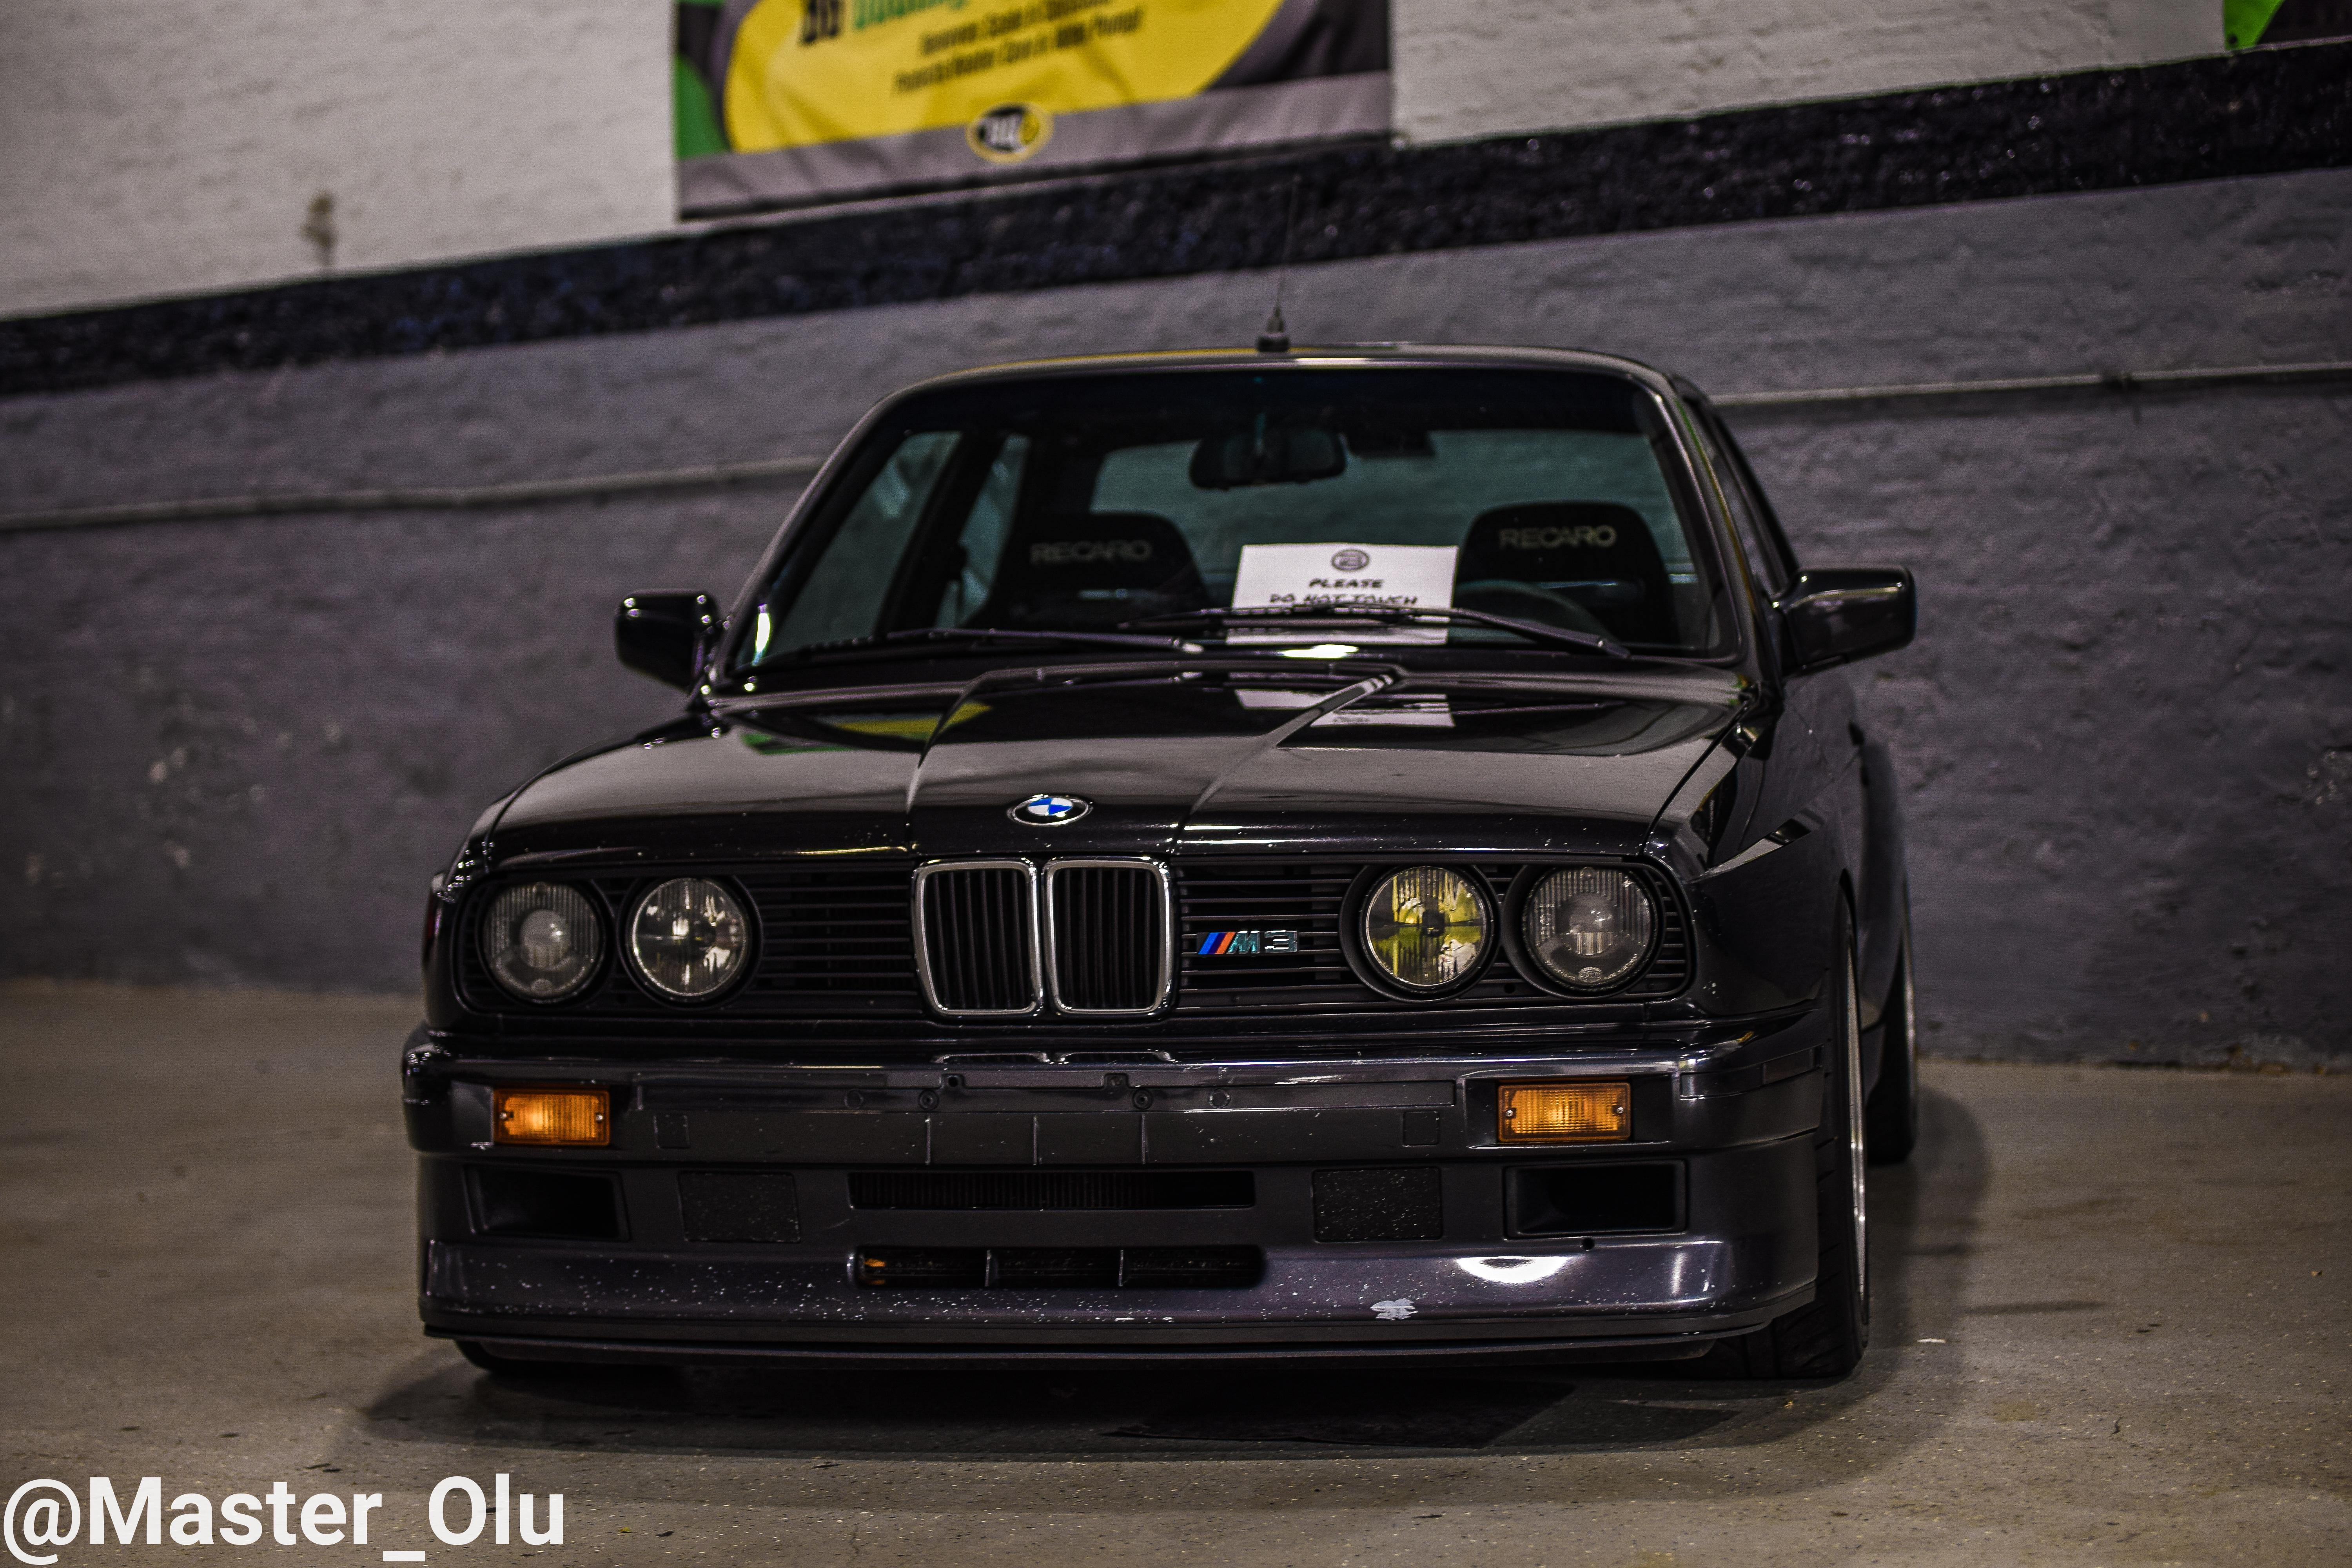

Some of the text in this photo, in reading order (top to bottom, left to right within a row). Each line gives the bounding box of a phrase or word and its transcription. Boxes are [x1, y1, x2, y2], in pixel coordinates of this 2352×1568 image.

[1499, 525, 1617, 549] RECARO
[1308, 578, 1383, 588] PLEASE
[1269, 593, 1295, 604] DO
[1226, 930, 1298, 954] M3
